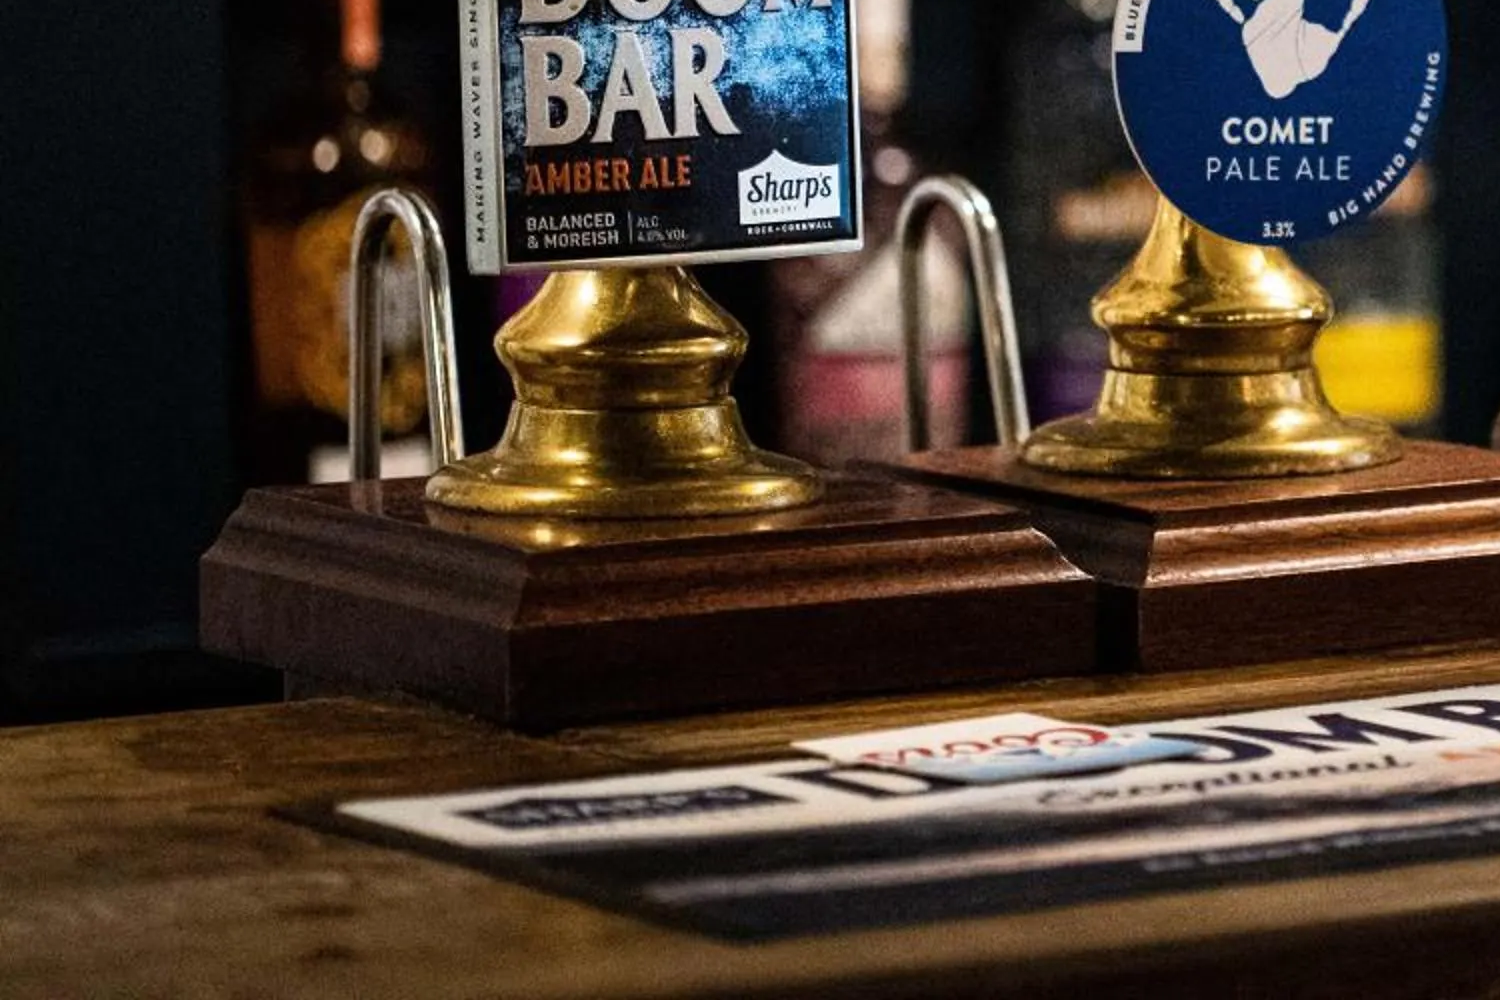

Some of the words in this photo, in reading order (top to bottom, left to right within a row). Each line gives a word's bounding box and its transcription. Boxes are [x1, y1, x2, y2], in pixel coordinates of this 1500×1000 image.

[470, 60, 482, 139] WAVES
[518, 27, 743, 147] BAR
[1221, 116, 1334, 145] COMET
[1328, 199, 1360, 226] BIG
[1363, 153, 1407, 202] HAND
[1404, 51, 1442, 151] BREWING
[524, 158, 632, 196] AMBER
[639, 154, 692, 189] ALE
[1206, 156, 1281, 182] PALE
[1295, 155, 1352, 181] ALE
[473, 151, 485, 243] MAKING
[747, 171, 832, 209] Sharp's
[525, 211, 615, 232] BALANCED
[527, 235, 540, 249] &
[543, 230, 619, 249] MOREISH
[1262, 222, 1296, 239] 3.3%
